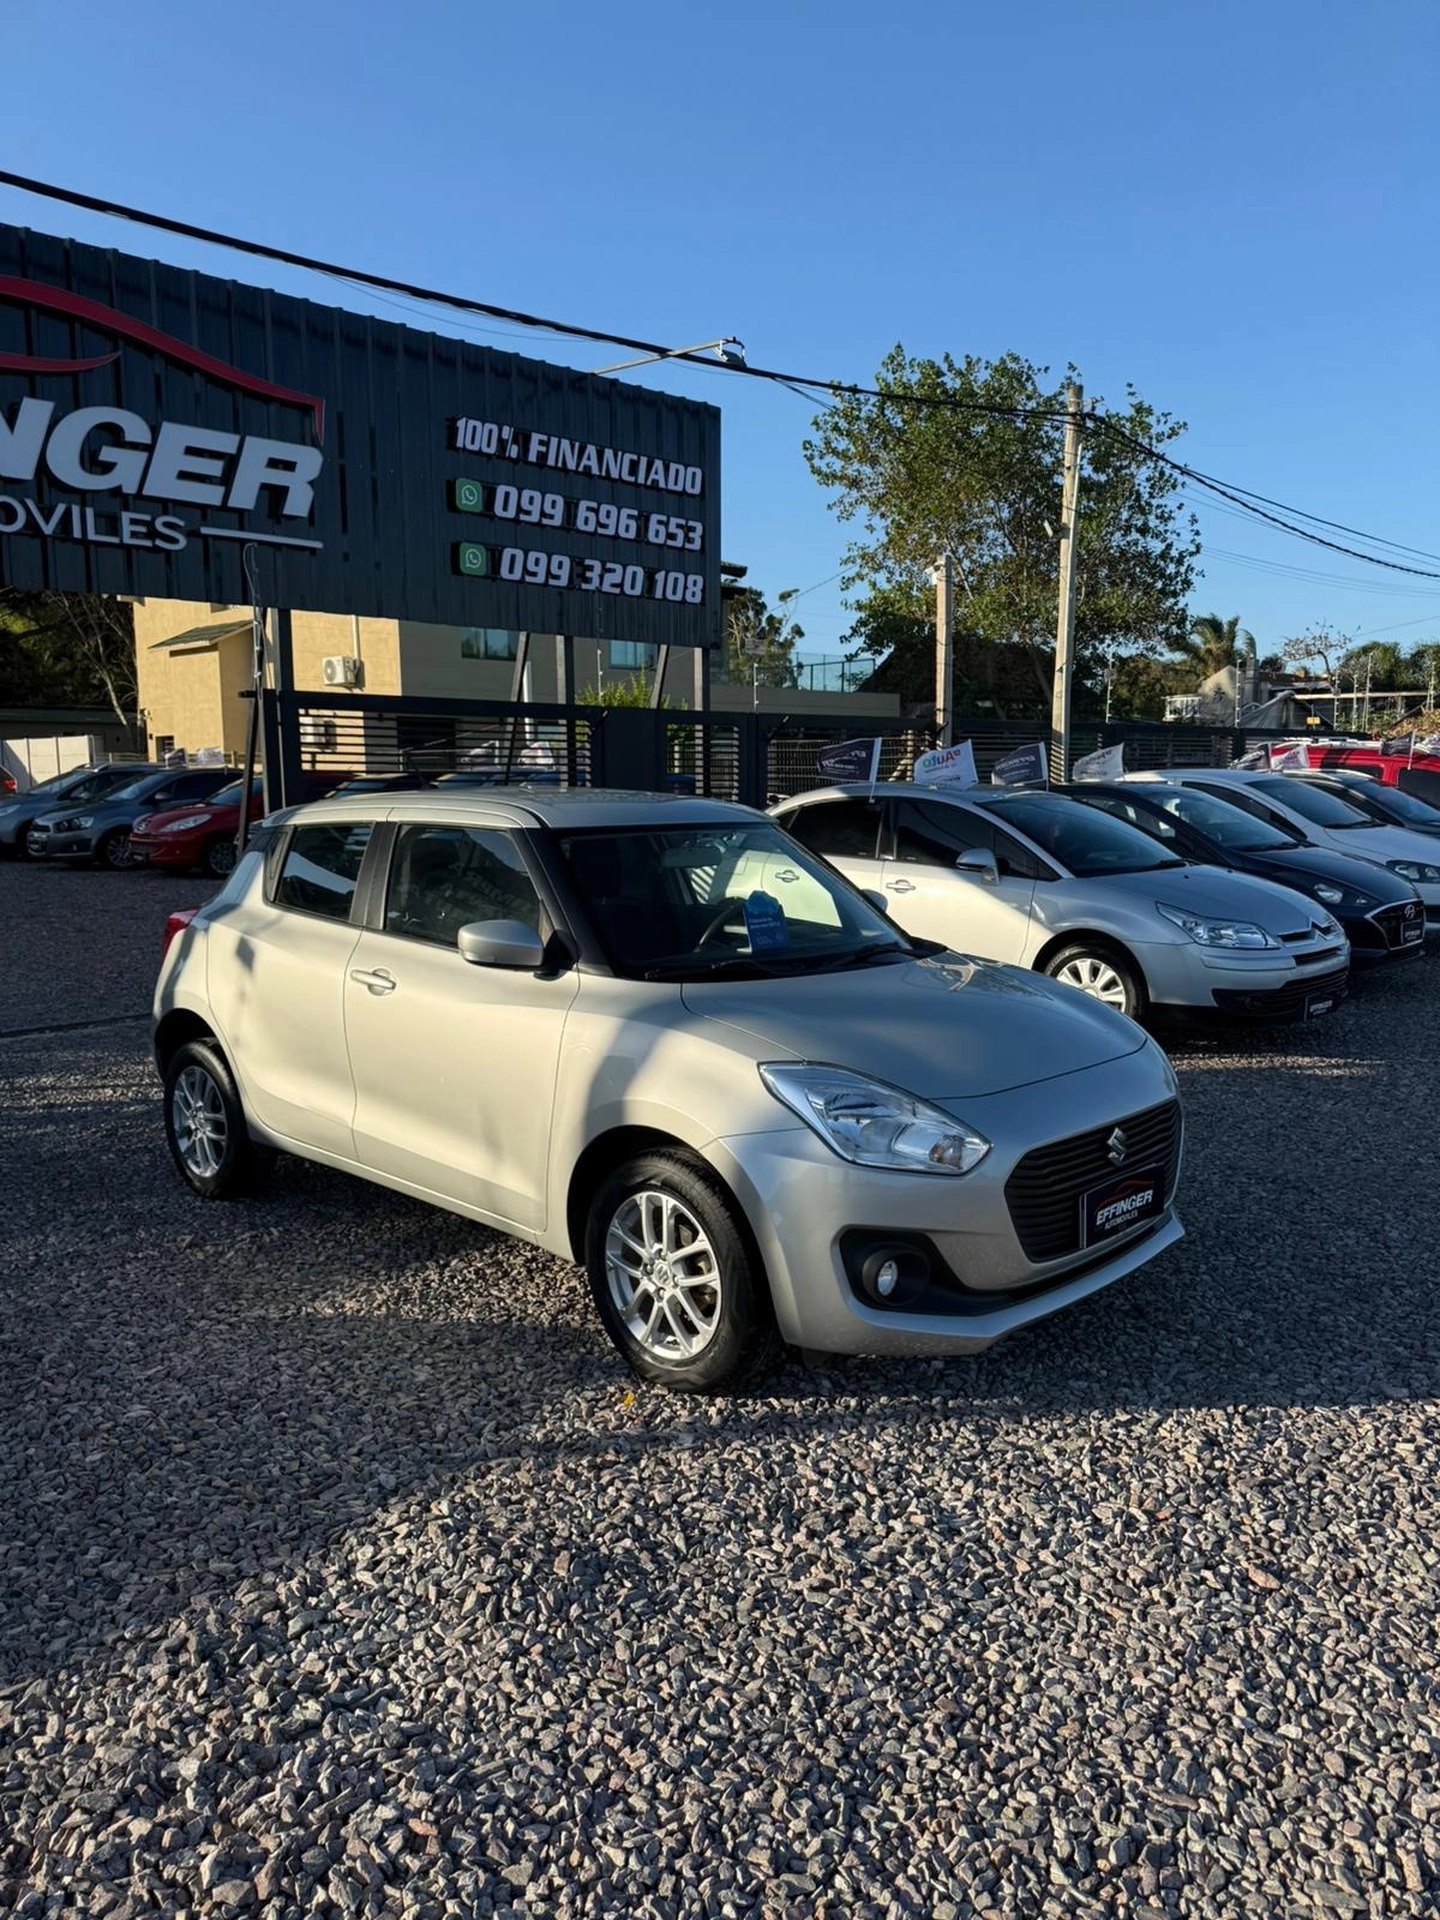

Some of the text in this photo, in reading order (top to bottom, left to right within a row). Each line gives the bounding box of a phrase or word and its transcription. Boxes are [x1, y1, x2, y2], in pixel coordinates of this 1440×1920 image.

[456, 417, 703, 496] 100% FINANCIADO
[493, 484, 703, 551] 099 696 653
[500, 547, 705, 604] 099 320 108
[1096, 1189, 1153, 1226] EFFINGER
